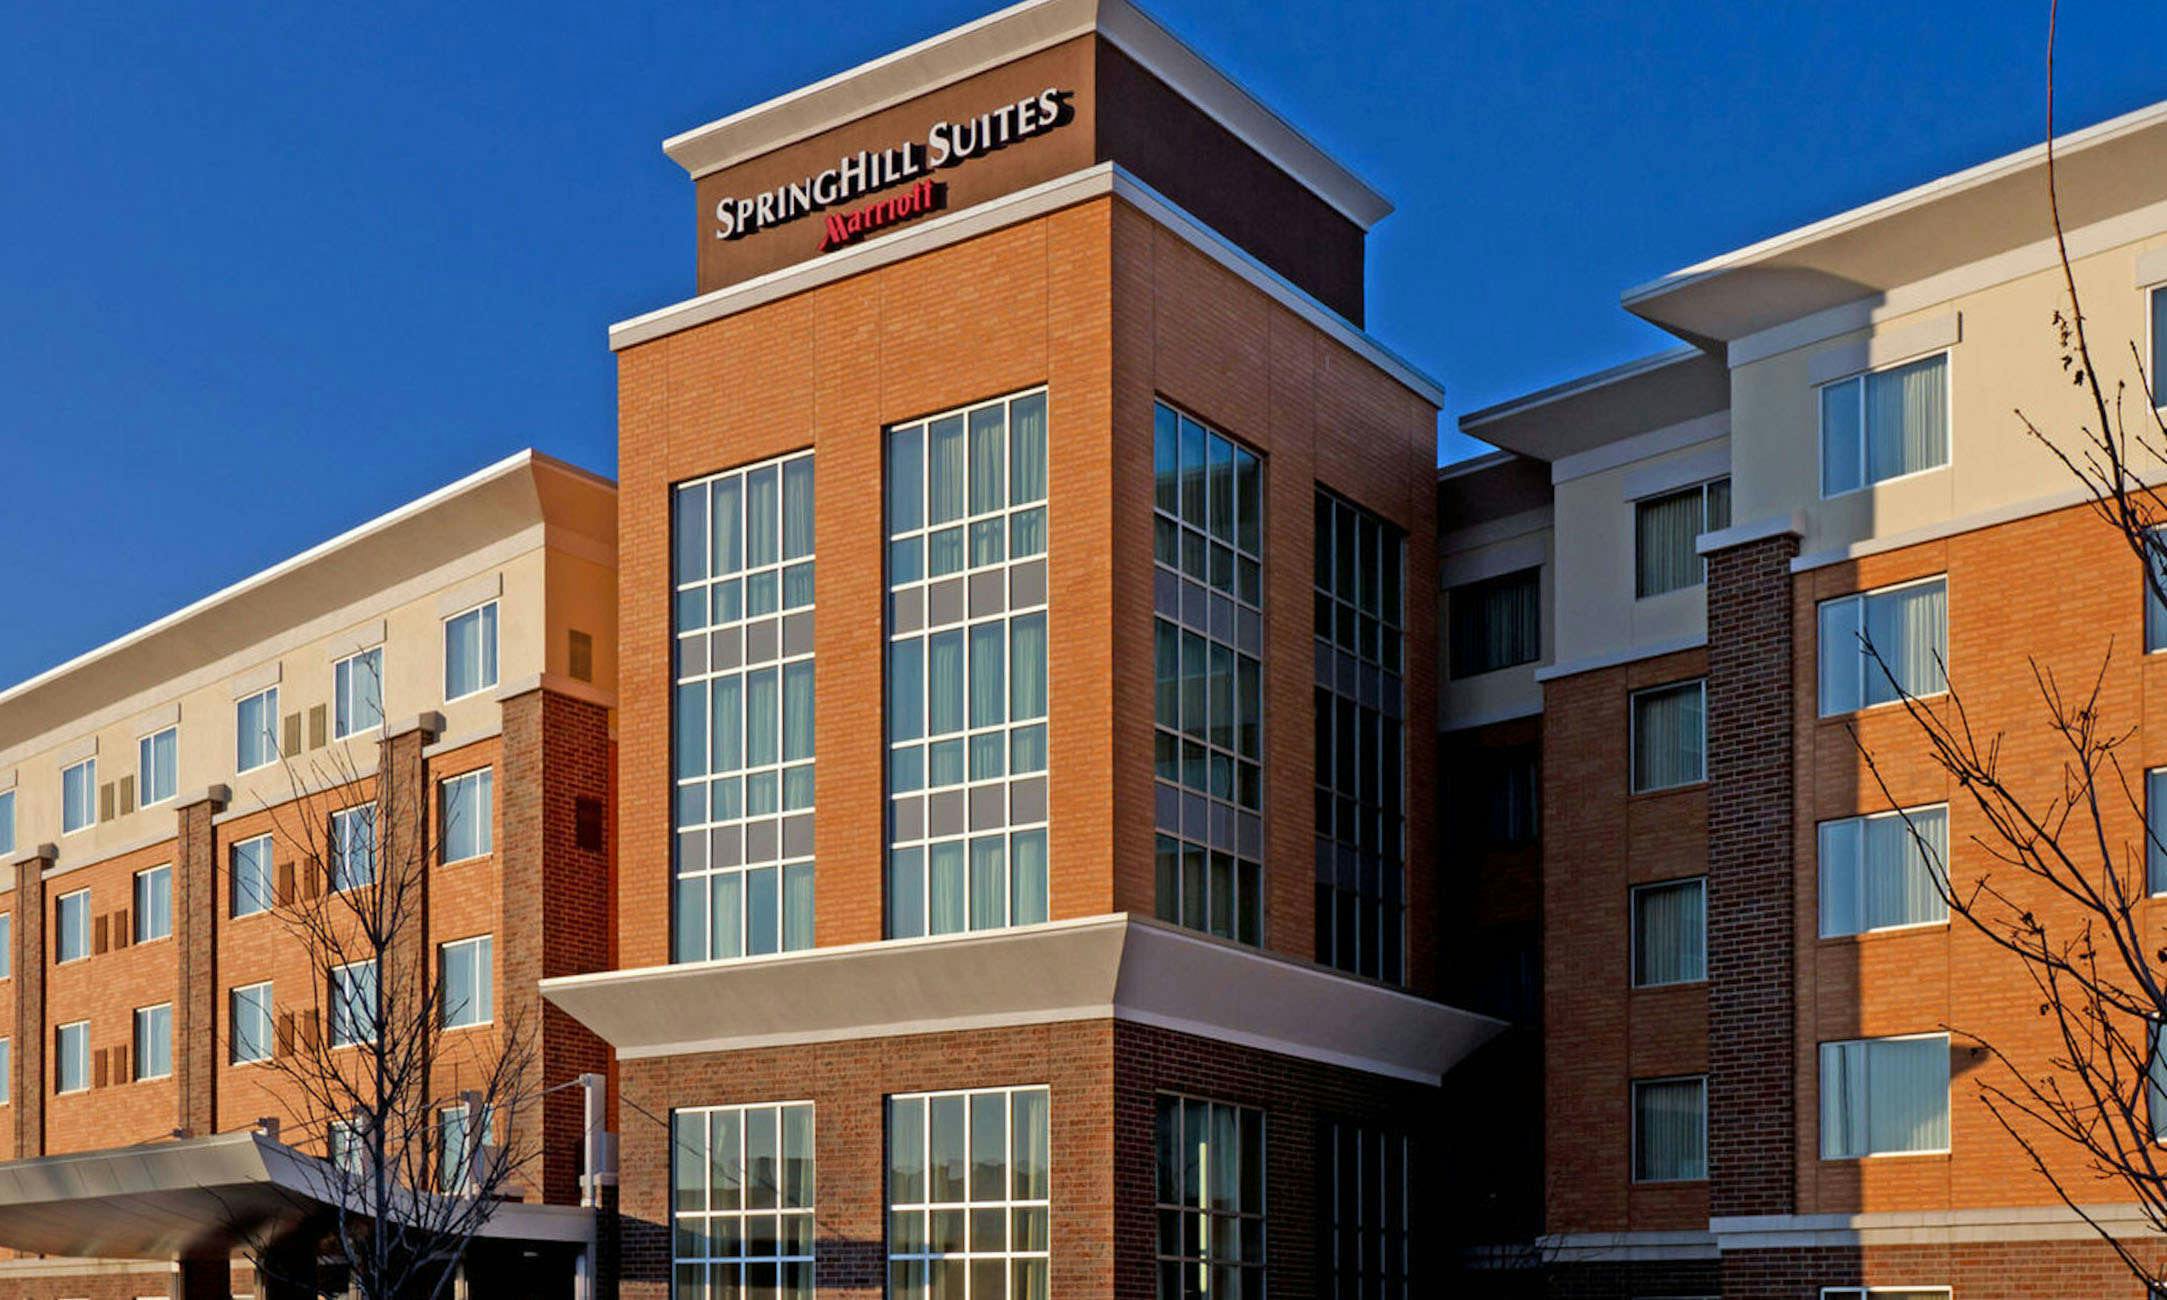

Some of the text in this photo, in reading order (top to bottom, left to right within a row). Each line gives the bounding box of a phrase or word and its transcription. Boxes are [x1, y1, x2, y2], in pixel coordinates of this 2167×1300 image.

[715, 87, 1060, 239] SPRINGHILL SUITES
[818, 178, 936, 252] Marriott
